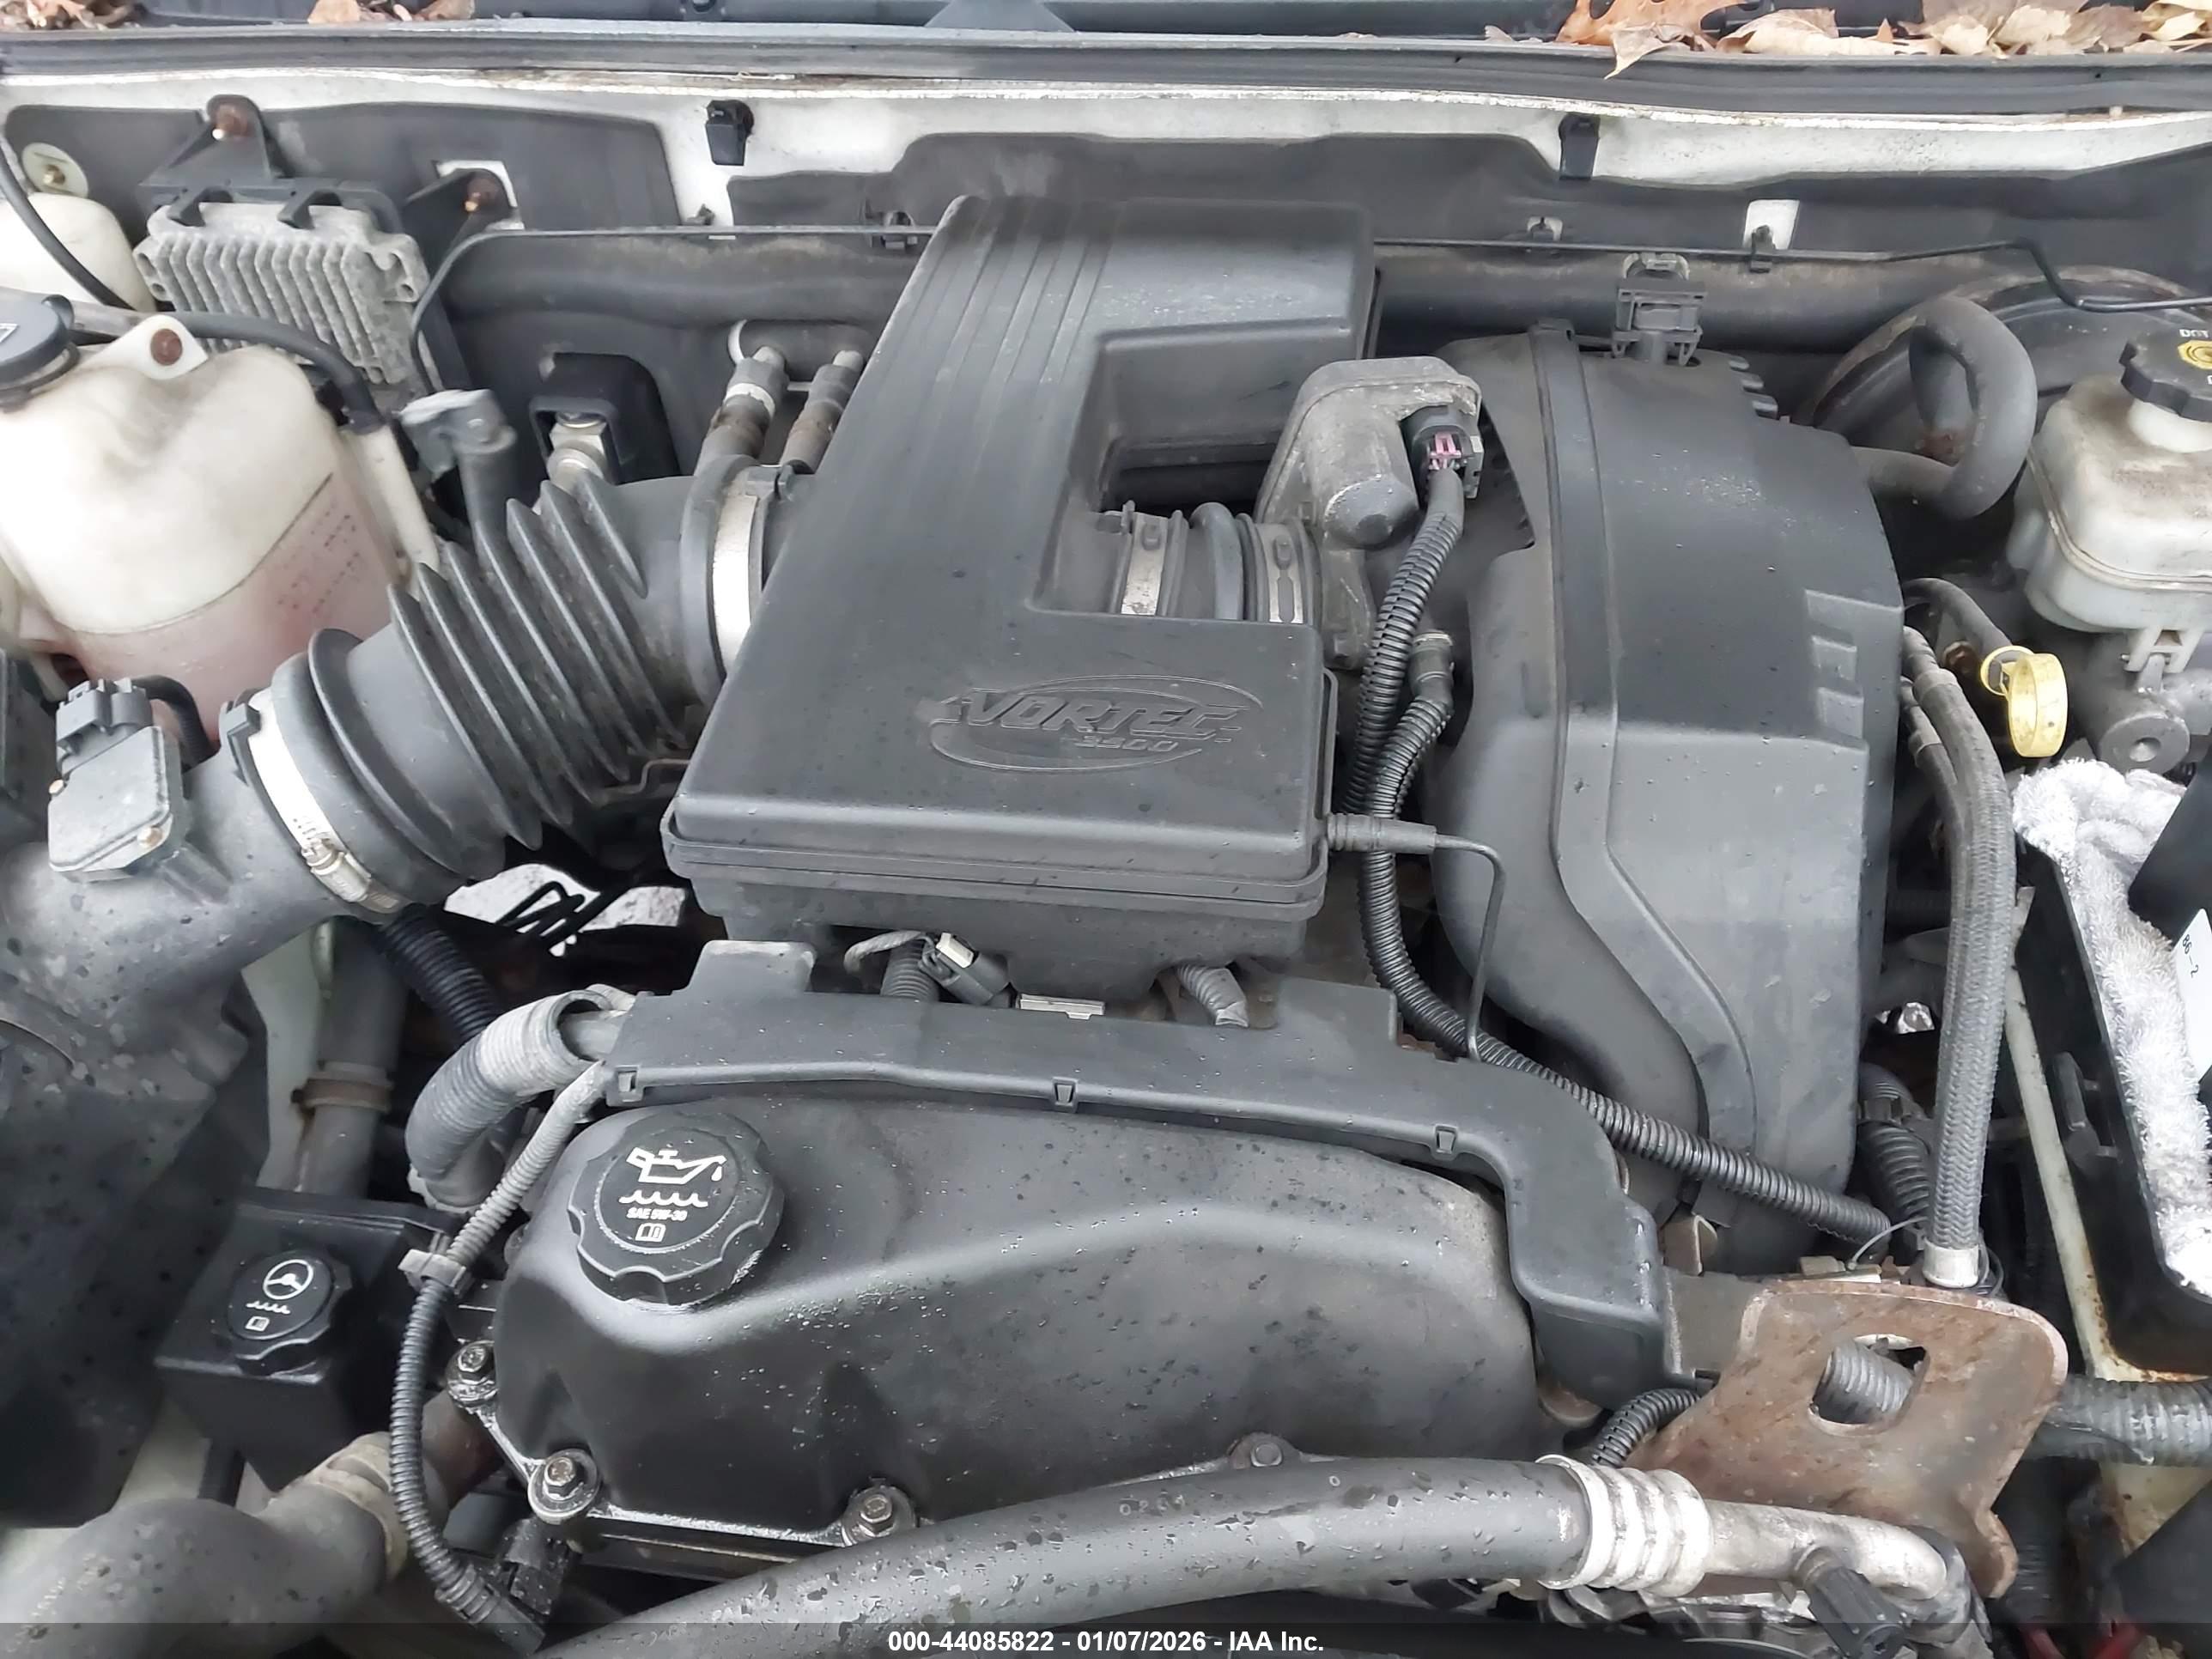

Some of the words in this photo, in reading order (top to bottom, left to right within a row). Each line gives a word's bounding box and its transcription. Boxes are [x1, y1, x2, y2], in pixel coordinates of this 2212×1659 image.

[960, 687, 1239, 741] VORTEC
[1073, 734, 1179, 753] 3500
[626, 1206, 650, 1219] SAE
